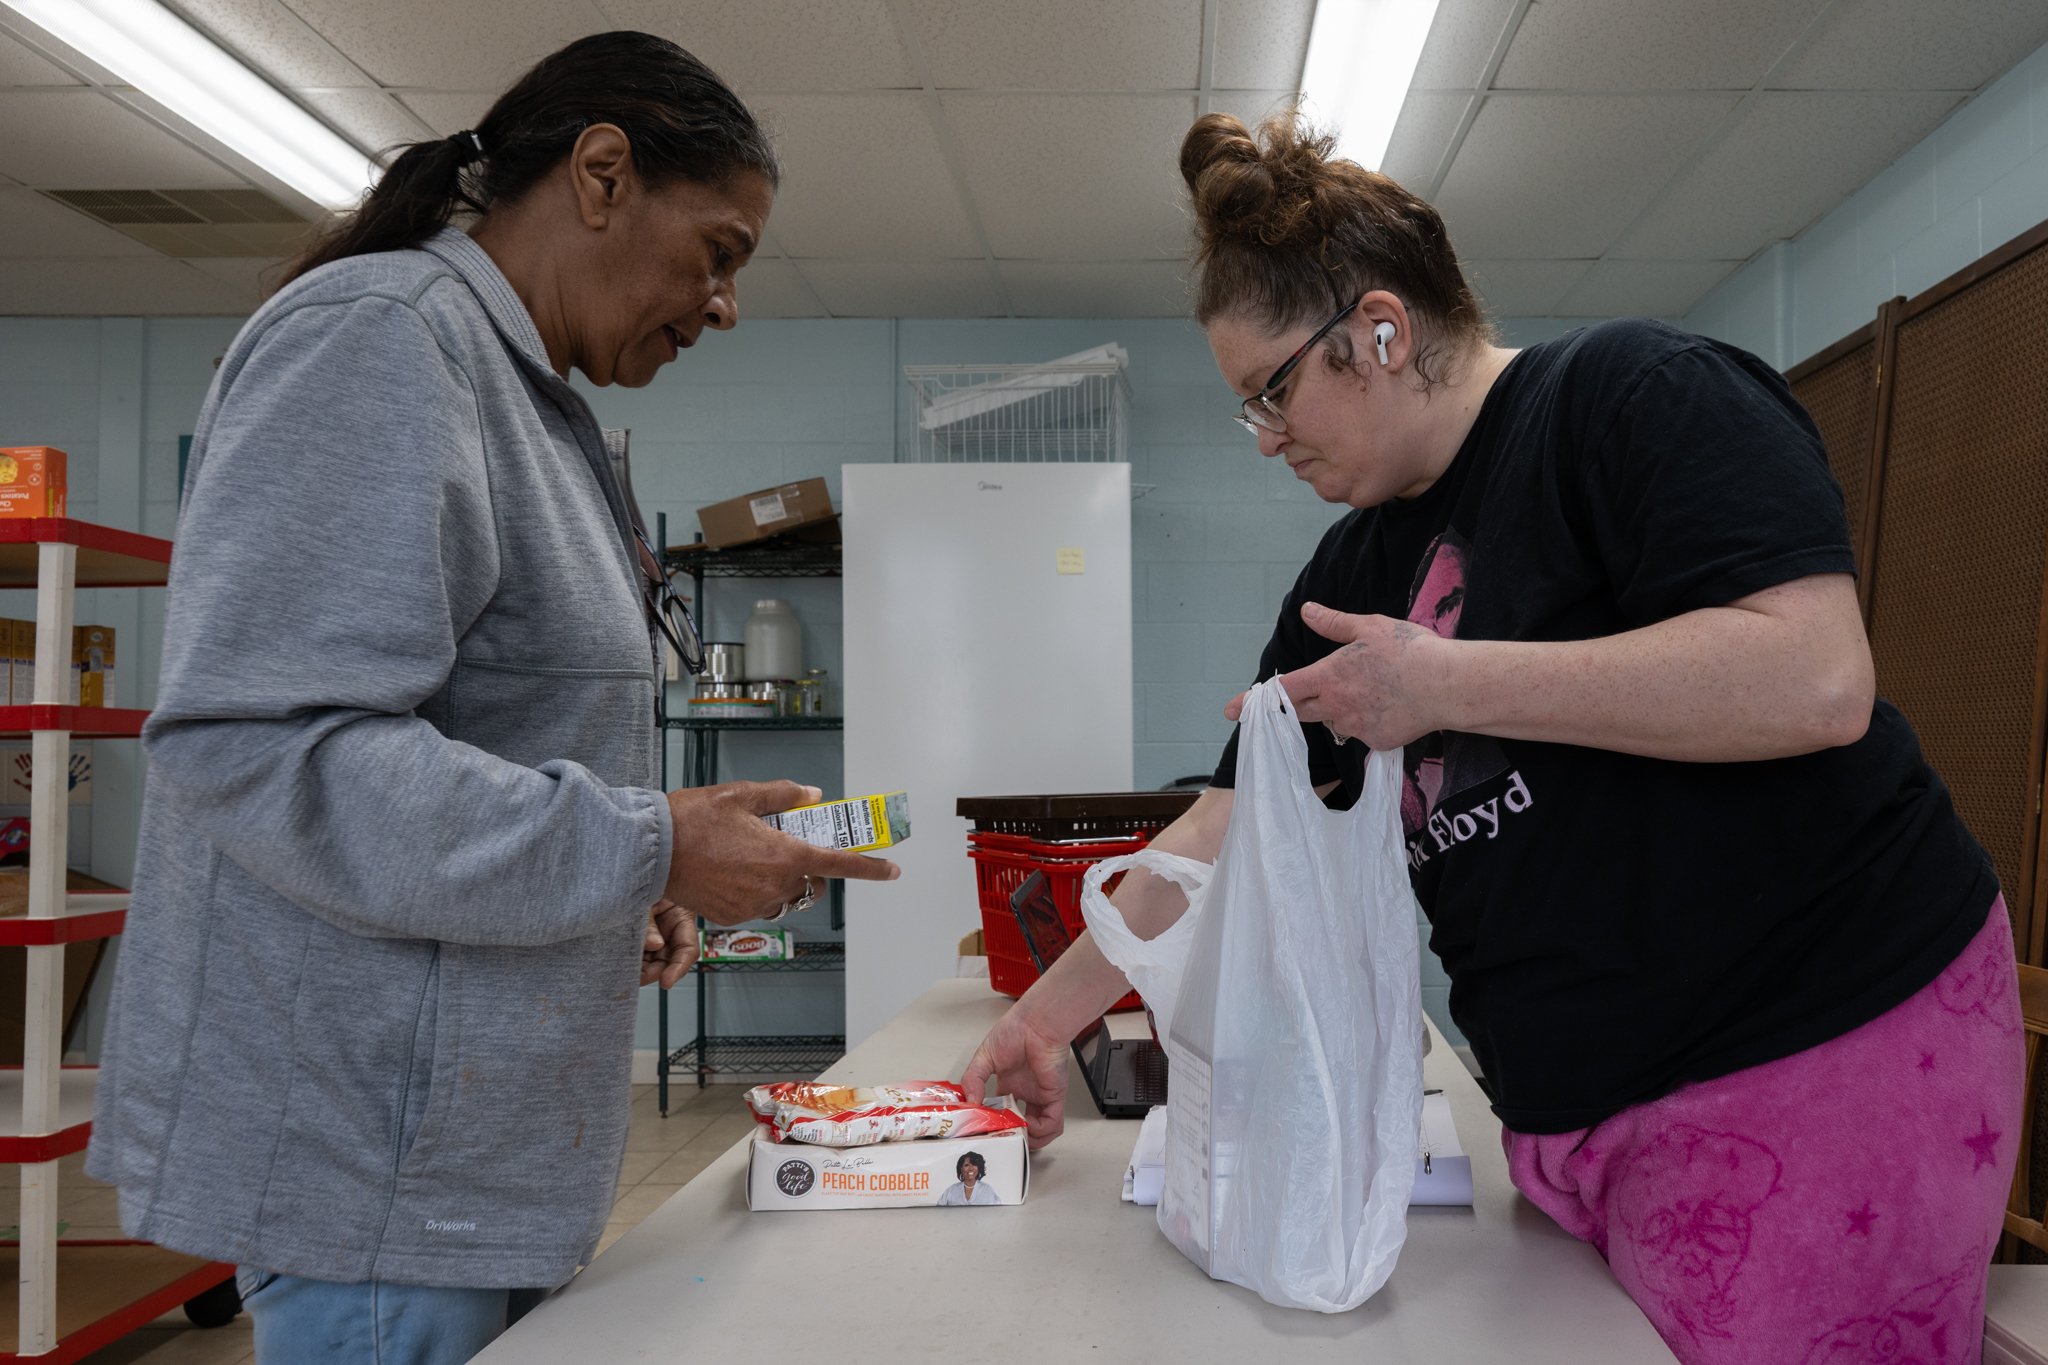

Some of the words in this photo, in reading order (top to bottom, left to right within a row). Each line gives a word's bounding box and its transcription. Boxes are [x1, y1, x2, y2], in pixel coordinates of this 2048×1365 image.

[860, 799, 871, 825] Nutrition
[833, 804, 842, 830] Calories
[838, 831, 849, 848] 150
[865, 826, 874, 843] Facts
[782, 1161, 809, 1172] PATTI'S
[779, 1171, 809, 1184] good
[822, 1171, 865, 1191] PEACH
[869, 1171, 929, 1191] COBBLER
[782, 1179, 807, 1195] life
